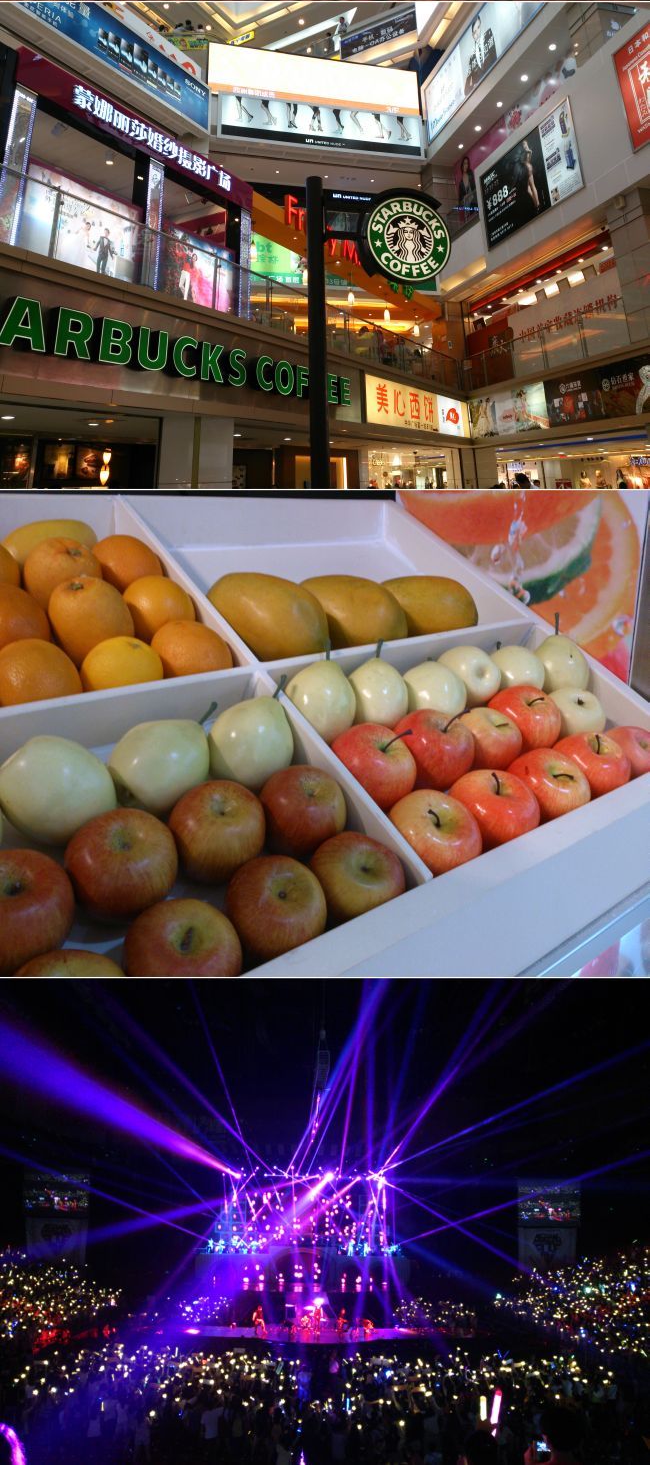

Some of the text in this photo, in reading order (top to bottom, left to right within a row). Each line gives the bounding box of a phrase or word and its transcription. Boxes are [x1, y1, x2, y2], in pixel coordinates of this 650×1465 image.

[184, 78, 207, 97] SONY
[73, 84, 232, 192] 蒙娜丽莎婚纱摄影广场
[371, 201, 446, 240] STARBUCKS
[380, 252, 440, 277] COFFEE
[0, 296, 352, 407] ARBUCKS COFEE
[375, 383, 435, 424] 美心西饼
